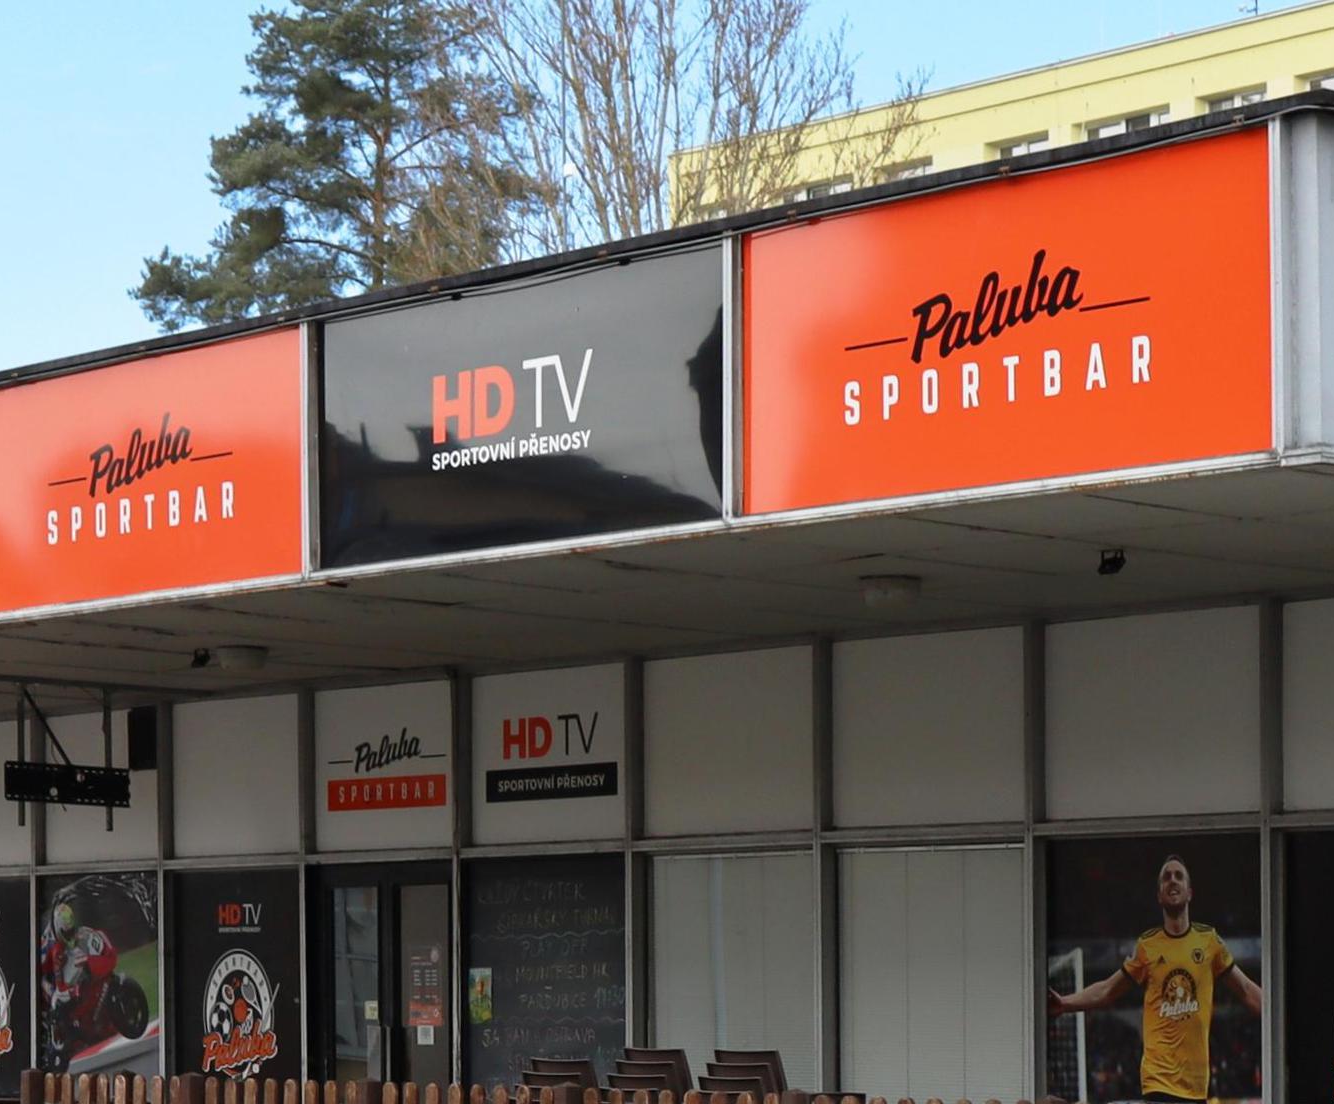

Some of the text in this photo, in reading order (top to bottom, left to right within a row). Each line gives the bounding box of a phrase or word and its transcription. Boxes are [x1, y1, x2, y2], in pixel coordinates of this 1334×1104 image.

[911, 249, 1083, 364] Paluba
[431, 348, 593, 444] HD TV
[844, 334, 1152, 425] SPORTBAR
[88, 412, 193, 498] Paluba
[431, 427, 592, 472] SPORTOVNÍ PŘENOSY
[47, 480, 234, 546] SPORTBAR
[354, 726, 422, 774] Paluba
[503, 711, 598, 760] HD TV
[338, 779, 437, 805] SPORTBAR
[497, 771, 606, 796] SPORTOVNÍ PŘENOSY
[219, 904, 262, 925] HD TV
[1159, 999, 1199, 1018] Paluba
[202, 1020, 278, 1073] Paluba
